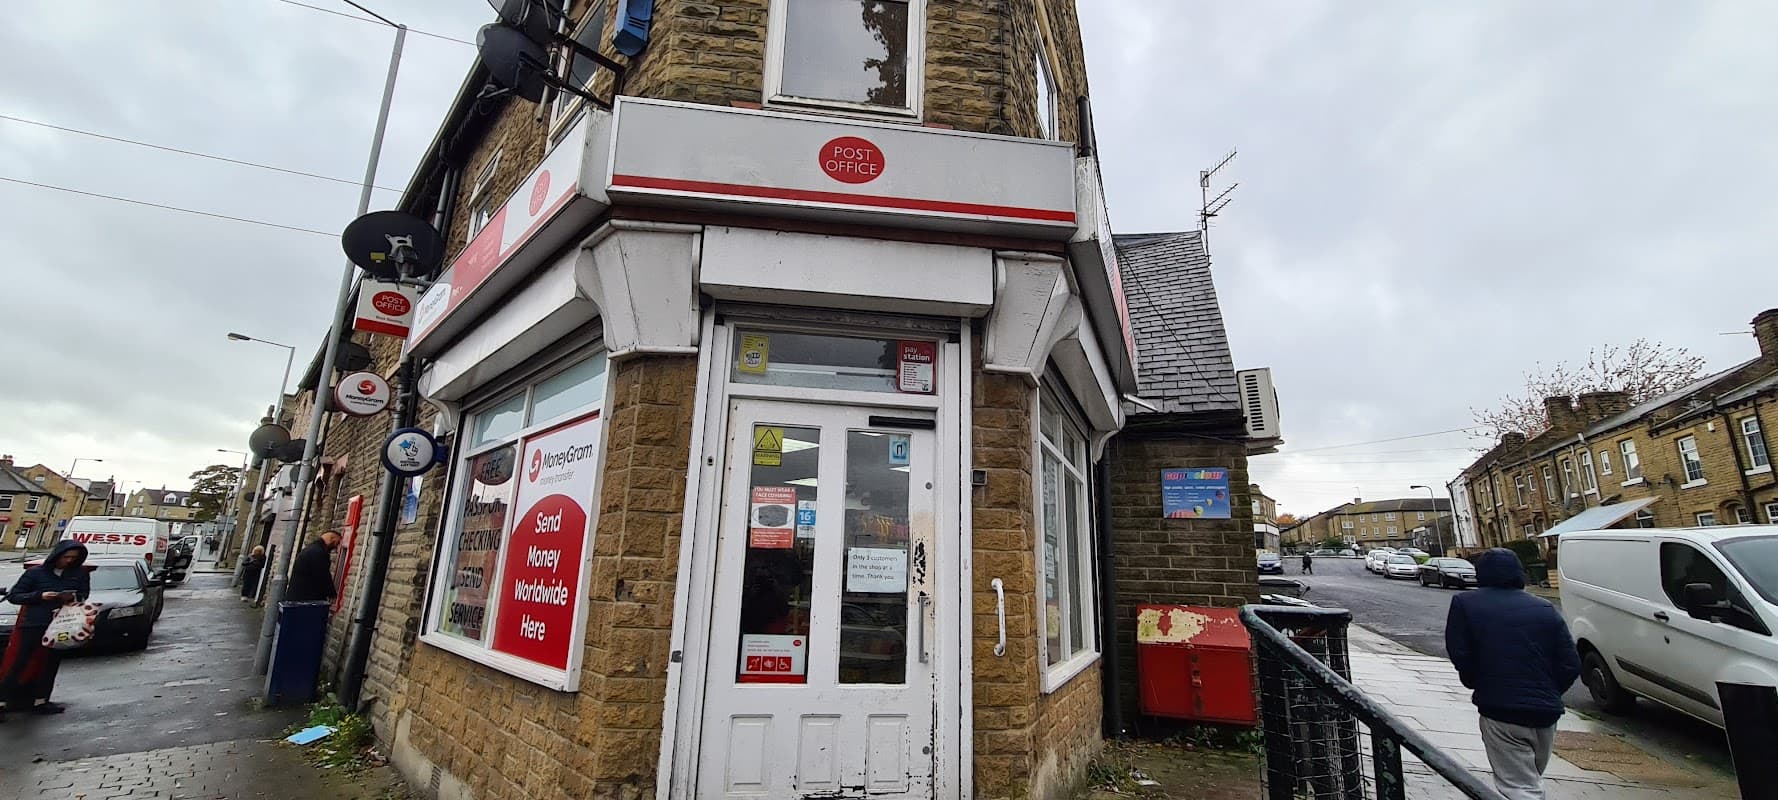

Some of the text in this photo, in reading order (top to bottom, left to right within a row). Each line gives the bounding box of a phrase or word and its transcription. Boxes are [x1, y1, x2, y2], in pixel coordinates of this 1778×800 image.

[834, 146, 873, 161] POST
[826, 160, 878, 175] OFFICE
[375, 300, 407, 313] OFFICE
[381, 295, 405, 305] POST
[903, 353, 930, 362] station
[904, 346, 918, 354] pay
[542, 443, 593, 470] MoneyGram
[480, 459, 501, 480] FREE
[464, 497, 506, 517] PASSPOR
[534, 508, 562, 534] Send
[72, 533, 147, 546] WESTS
[458, 529, 501, 552] CHECKING
[526, 545, 561, 573] Money
[460, 567, 484, 589] SEND
[514, 578, 569, 606] Worldwide
[449, 602, 484, 629] SERVICE
[520, 613, 546, 641] Here
